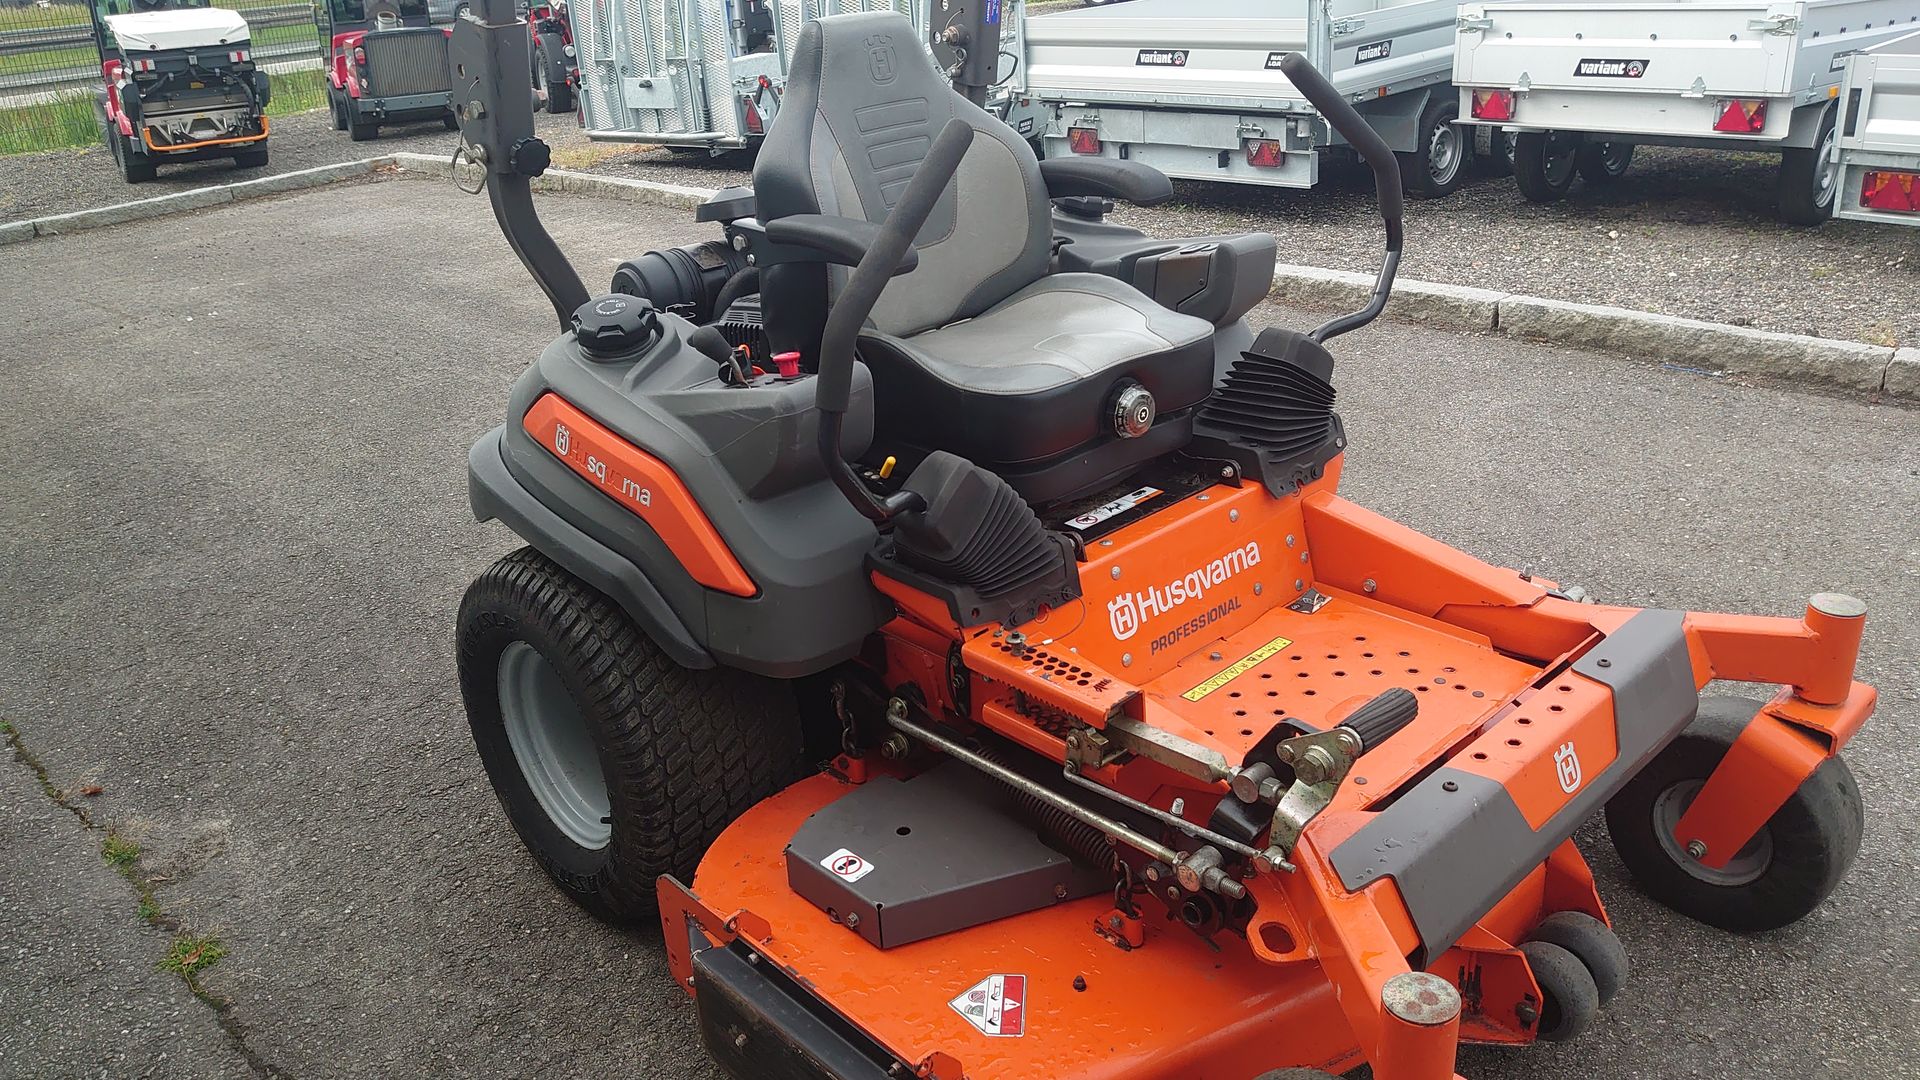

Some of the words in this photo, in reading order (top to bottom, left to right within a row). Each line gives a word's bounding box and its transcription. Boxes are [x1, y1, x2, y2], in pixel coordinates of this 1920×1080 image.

[1139, 50, 1173, 64] variant
[1358, 45, 1382, 61] variant
[1580, 60, 1626, 75] variant
[1135, 541, 1262, 624] Husqvarna
[1150, 596, 1242, 656] PROFESSIONAL
